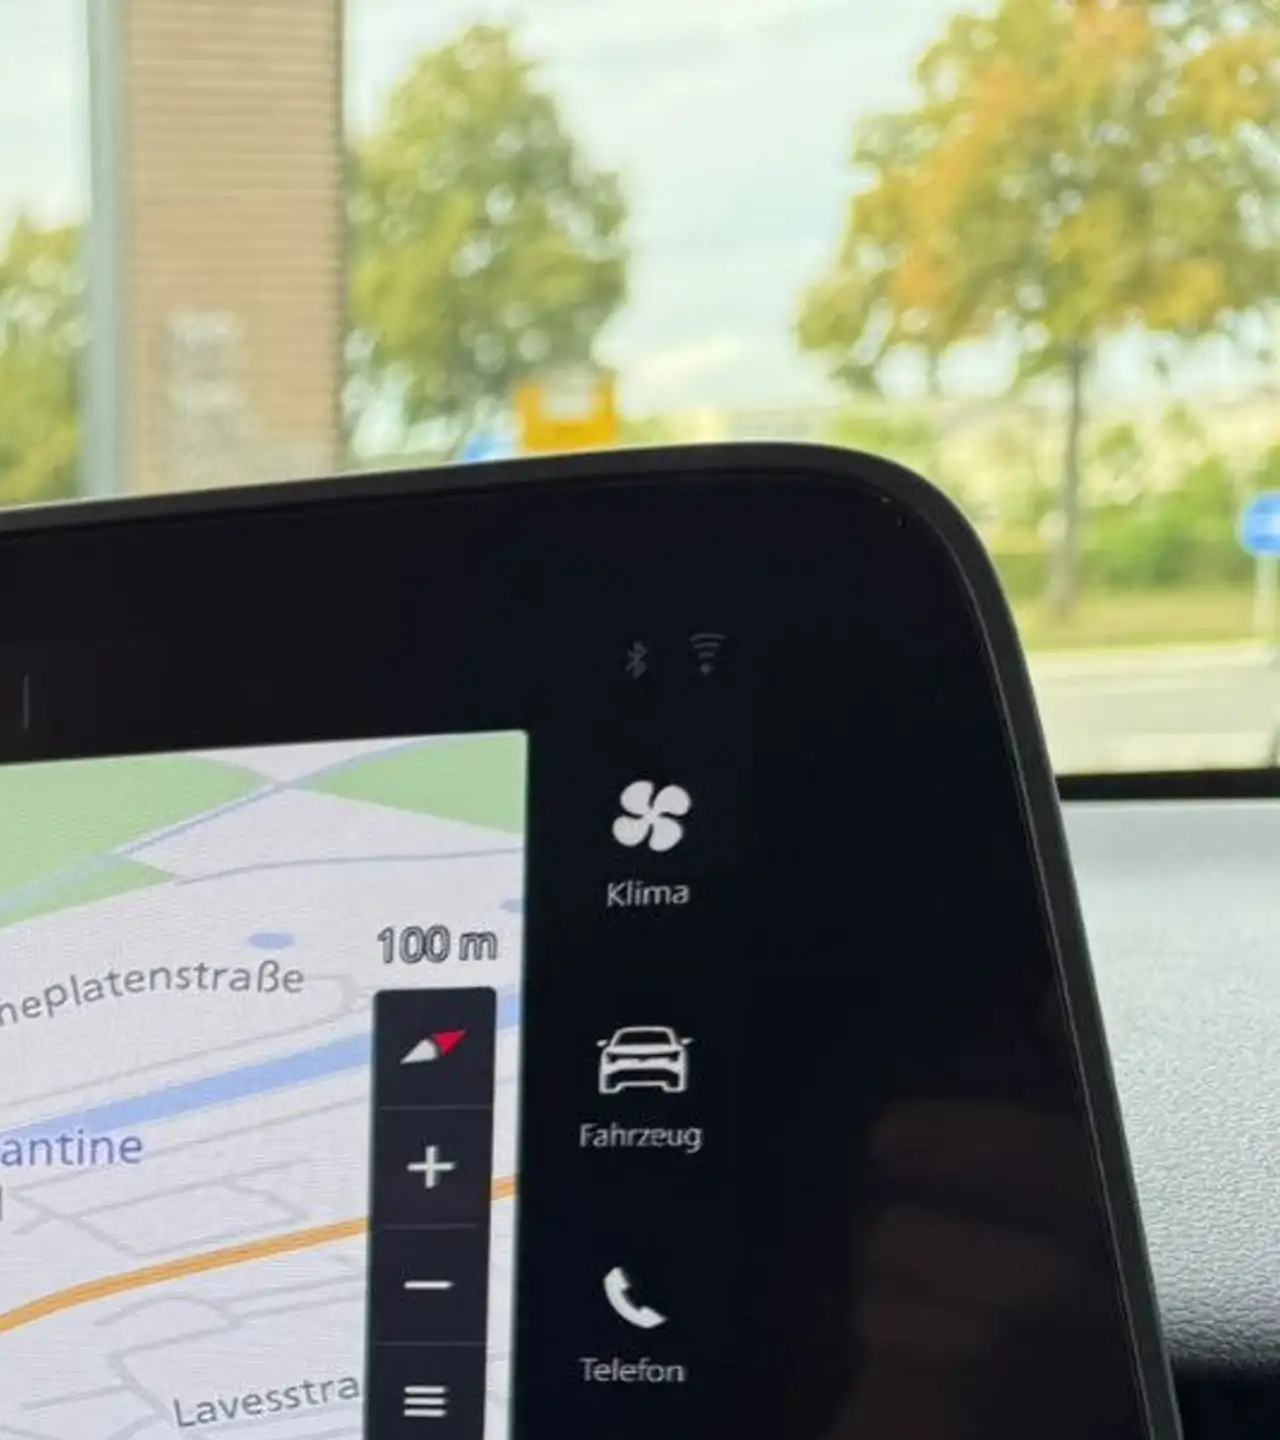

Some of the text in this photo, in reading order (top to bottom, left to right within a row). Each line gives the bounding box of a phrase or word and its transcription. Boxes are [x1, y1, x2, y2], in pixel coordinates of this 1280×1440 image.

[606, 880, 690, 908] Klima
[377, 925, 498, 965] 100 m
[578, 1122, 704, 1152] Fahrzeug
[579, 1357, 685, 1383] Telefon
